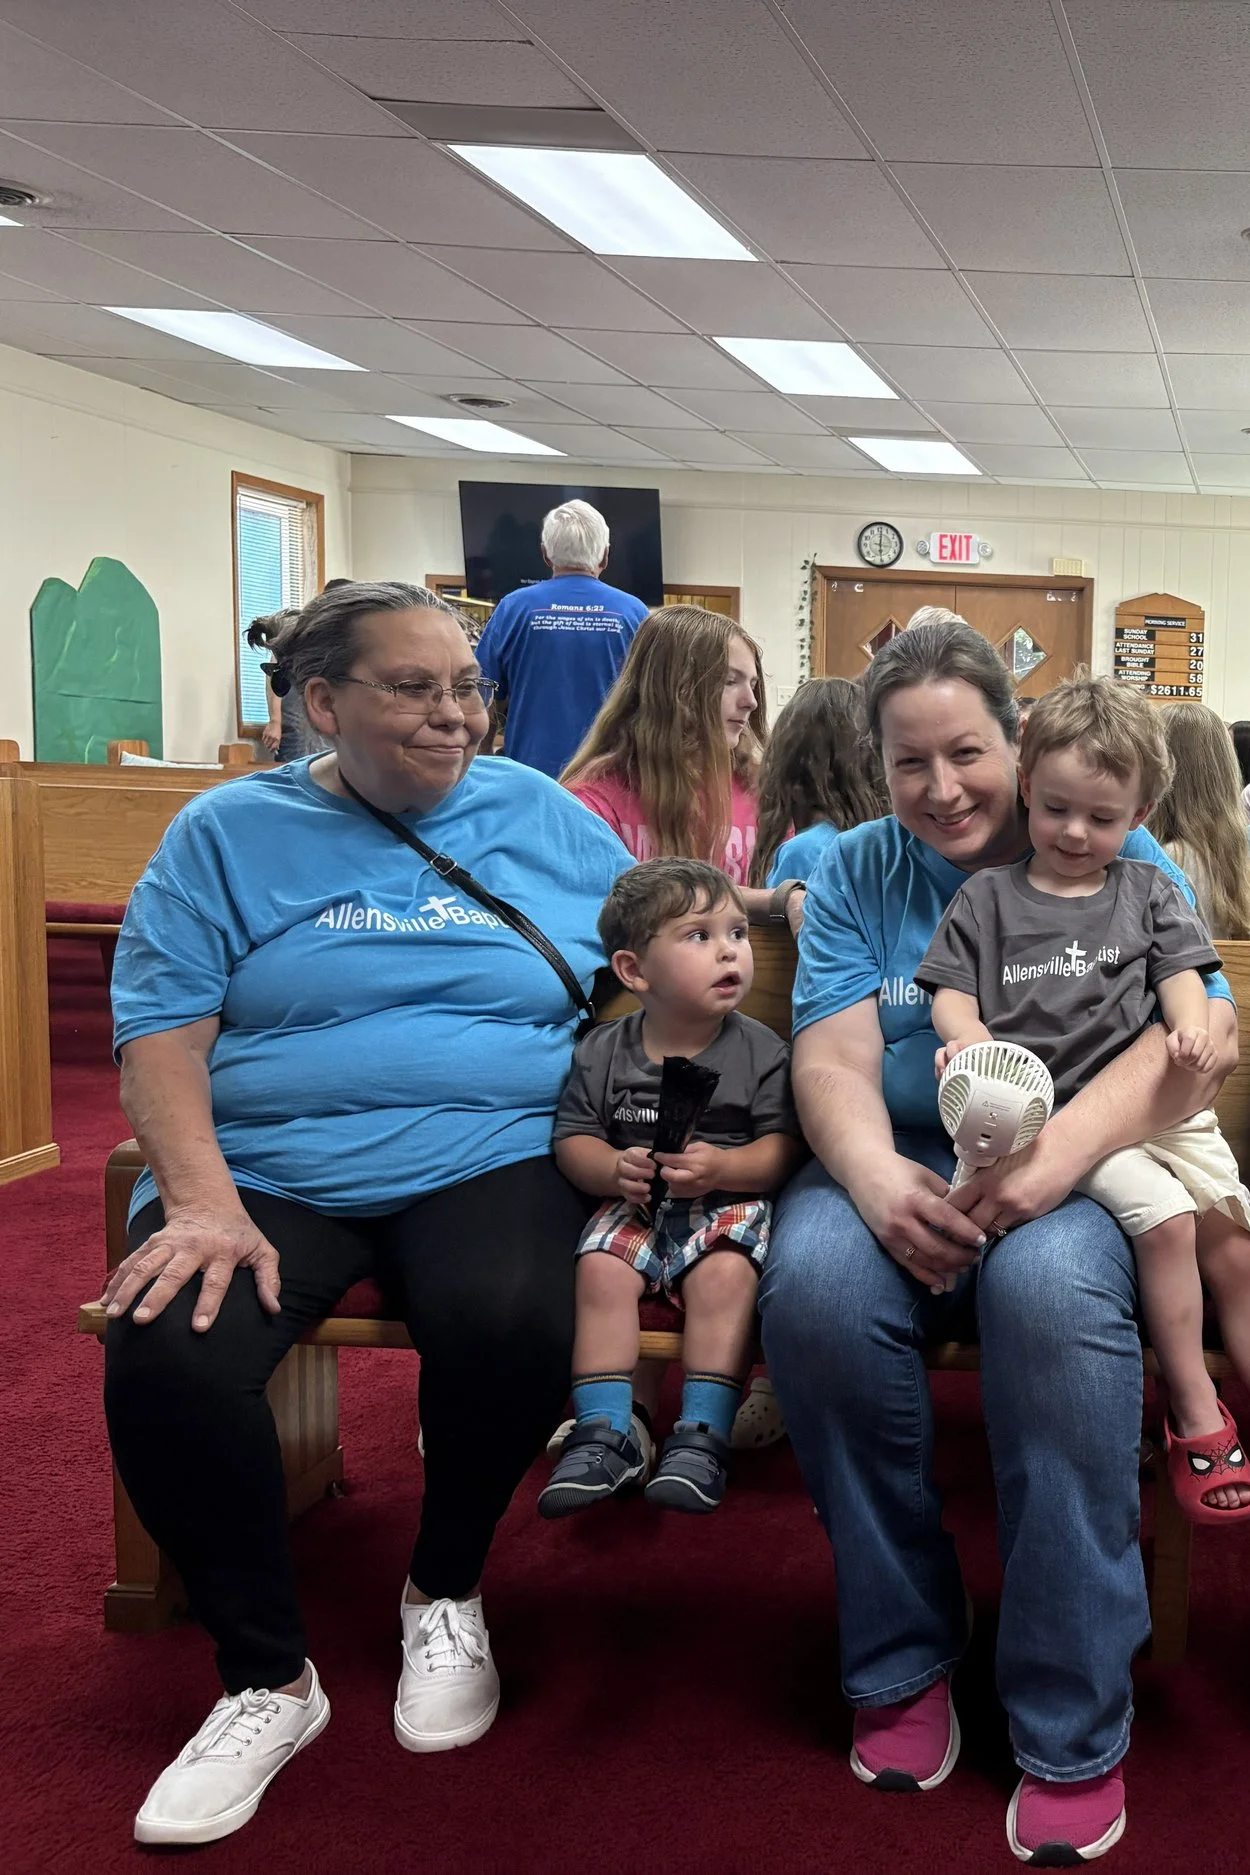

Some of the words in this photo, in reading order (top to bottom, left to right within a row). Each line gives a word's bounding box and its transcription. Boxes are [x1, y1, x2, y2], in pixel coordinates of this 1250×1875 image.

[938, 533, 973, 561] EXIT
[551, 603, 583, 611] Romans
[1190, 633, 1203, 643] 31
[1190, 646, 1203, 656] 27
[1190, 659, 1203, 670] 20
[1189, 673, 1203, 683] 58
[1150, 685, 1202, 697] $2611.65
[315, 902, 446, 932] Allensville
[452, 906, 511, 930] Bap
[1002, 956, 1071, 985] Allensville
